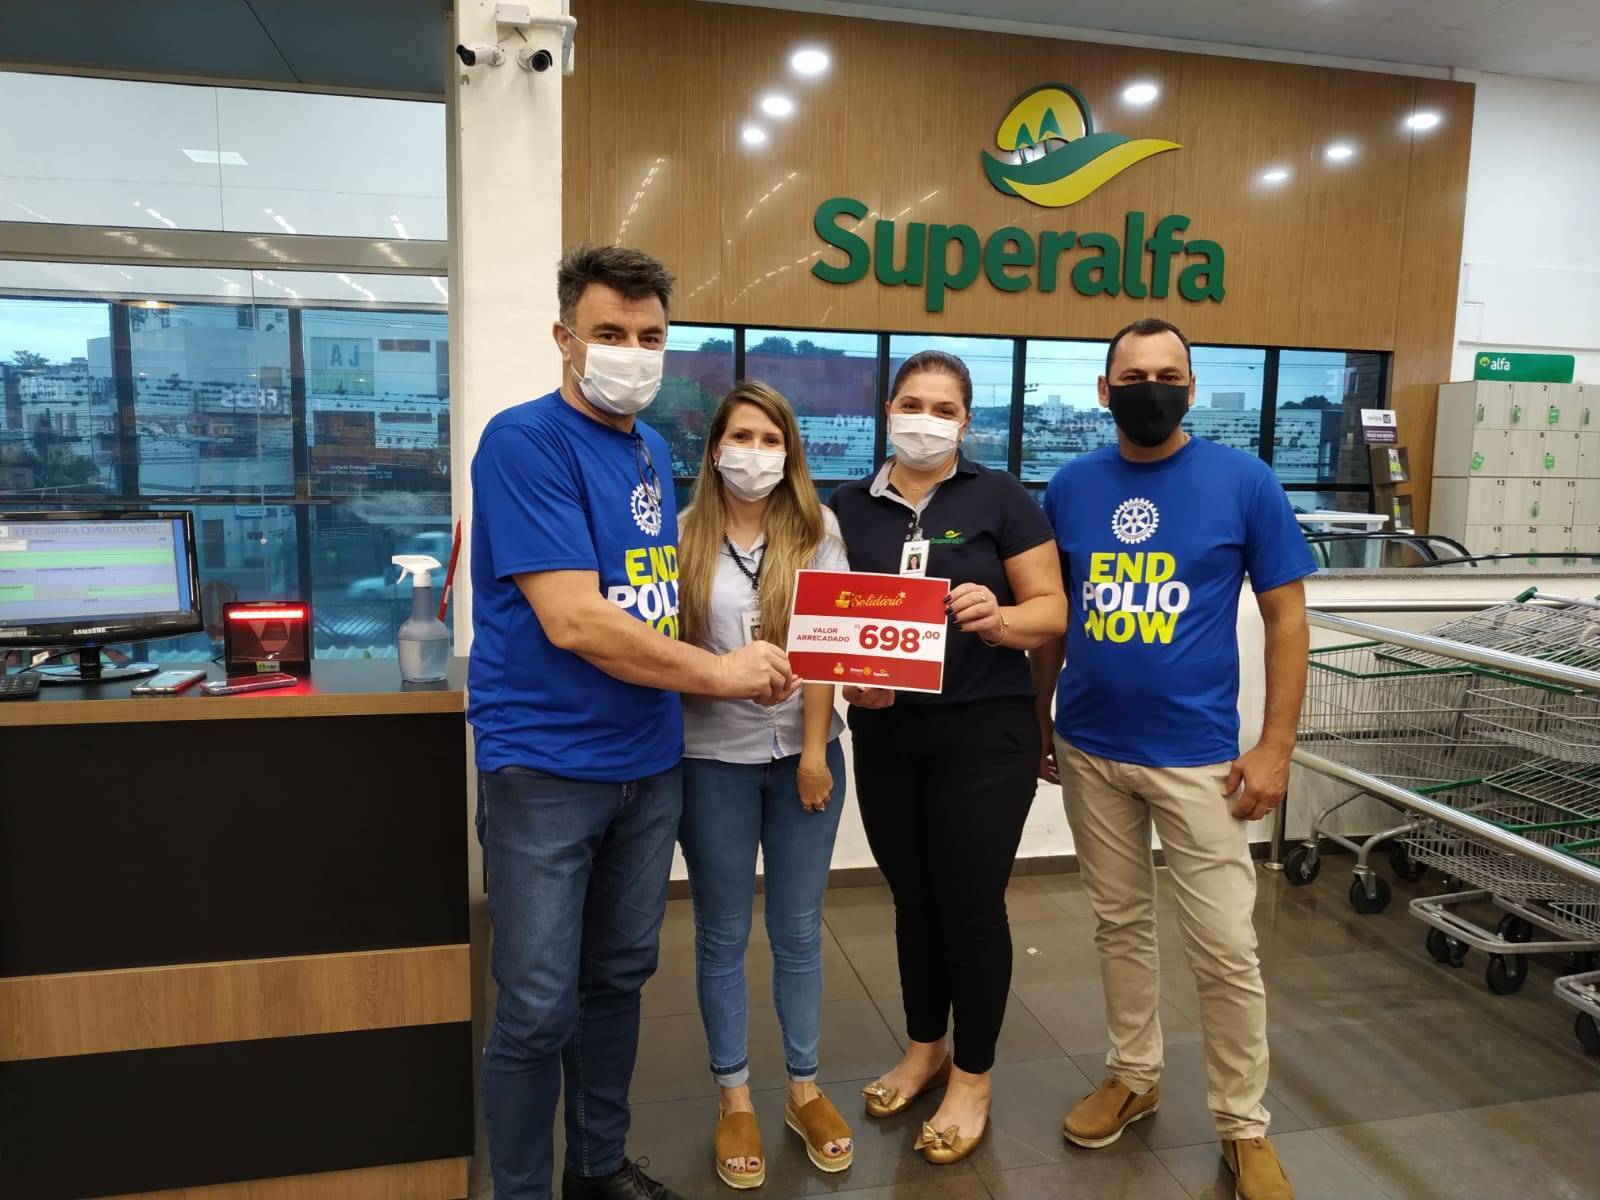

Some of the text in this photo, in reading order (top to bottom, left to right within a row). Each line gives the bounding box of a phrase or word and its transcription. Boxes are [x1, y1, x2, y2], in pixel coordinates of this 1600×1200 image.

[811, 197, 1227, 312] Superalfa
[1490, 358, 1511, 371] alfa
[625, 545, 679, 586] END
[1089, 552, 1176, 584] END
[852, 593, 904, 608] Solidário
[1082, 581, 1190, 613] POLIO
[796, 635, 850, 643] ARRECADADO
[1084, 610, 1179, 644] NOW
